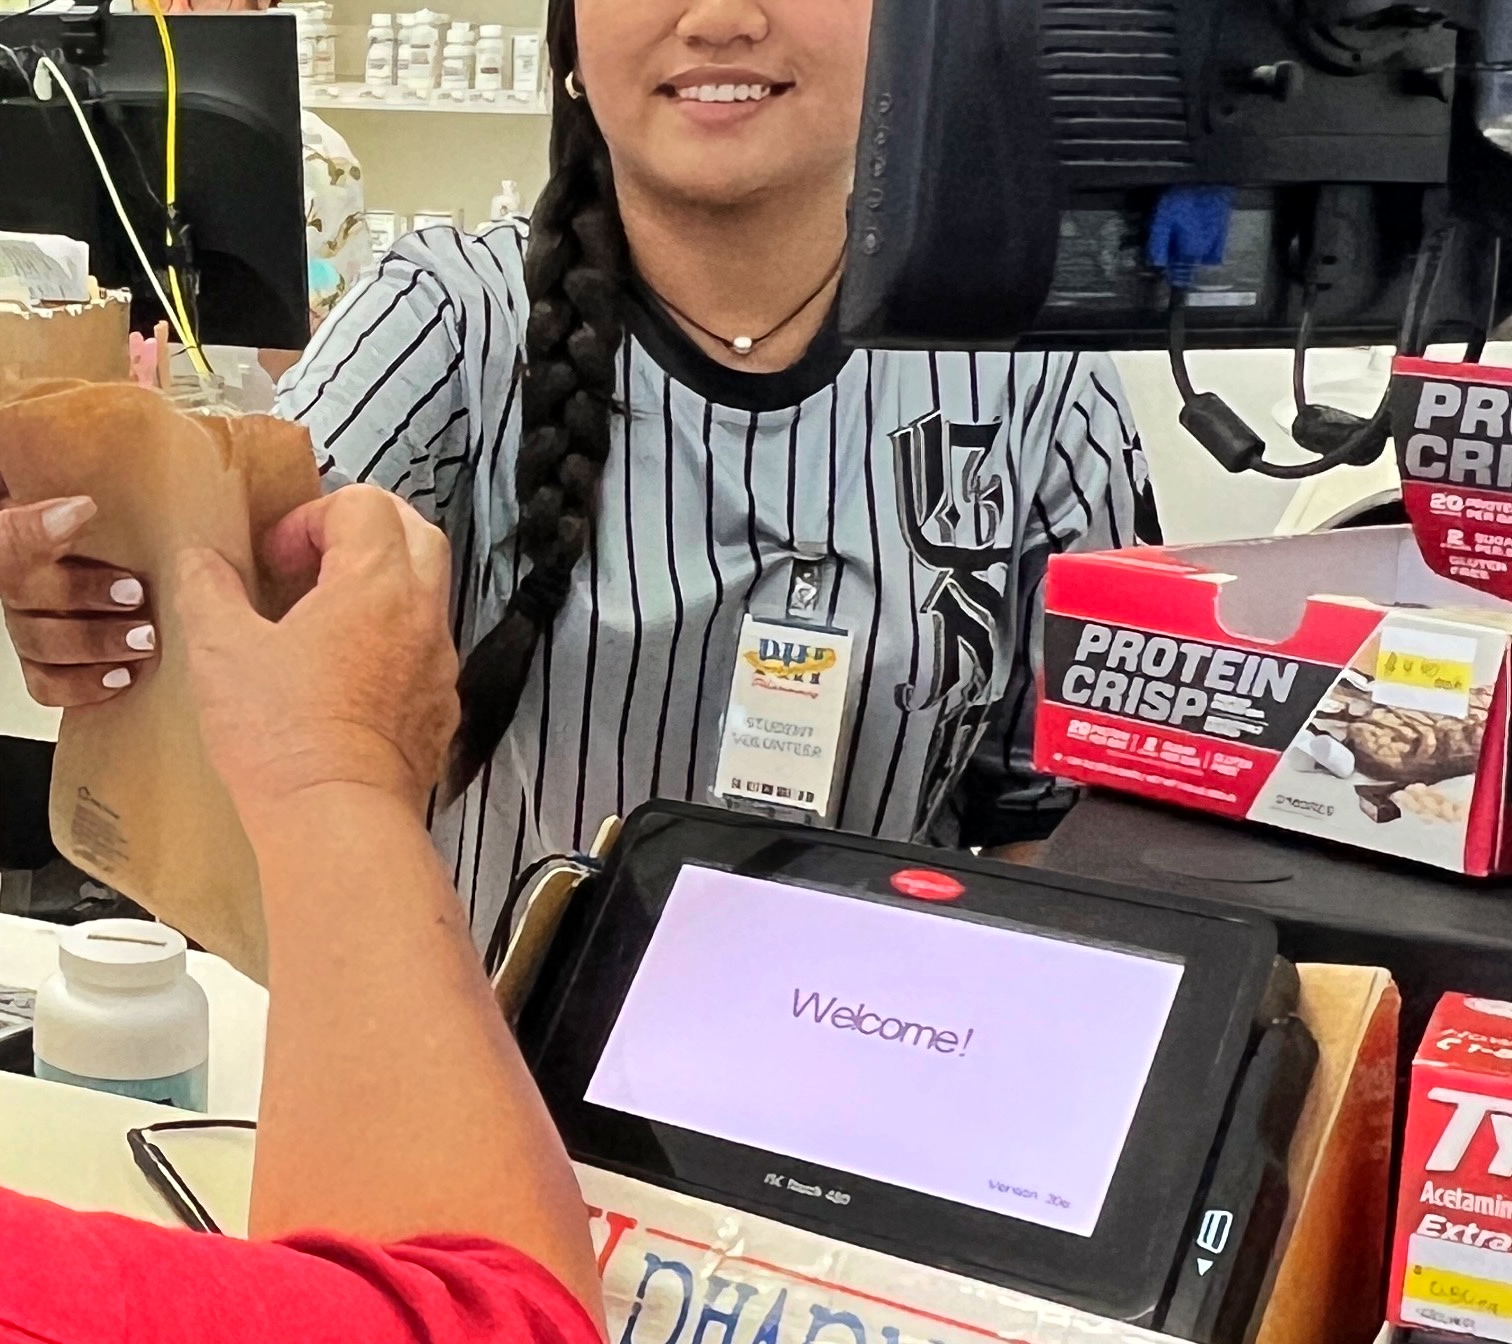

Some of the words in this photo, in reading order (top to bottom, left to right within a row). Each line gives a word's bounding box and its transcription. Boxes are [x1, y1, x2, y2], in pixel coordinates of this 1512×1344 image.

[1414, 381, 1512, 438] PR
[1430, 492, 1465, 512] 20
[1074, 622, 1299, 703] PROTEIN
[1061, 666, 1209, 725] CRISP
[731, 732, 823, 758] VOLUNTEER
[745, 716, 814, 737] STUDENT
[790, 987, 975, 1058] Welcome!
[1416, 1212, 1512, 1253] Extra
